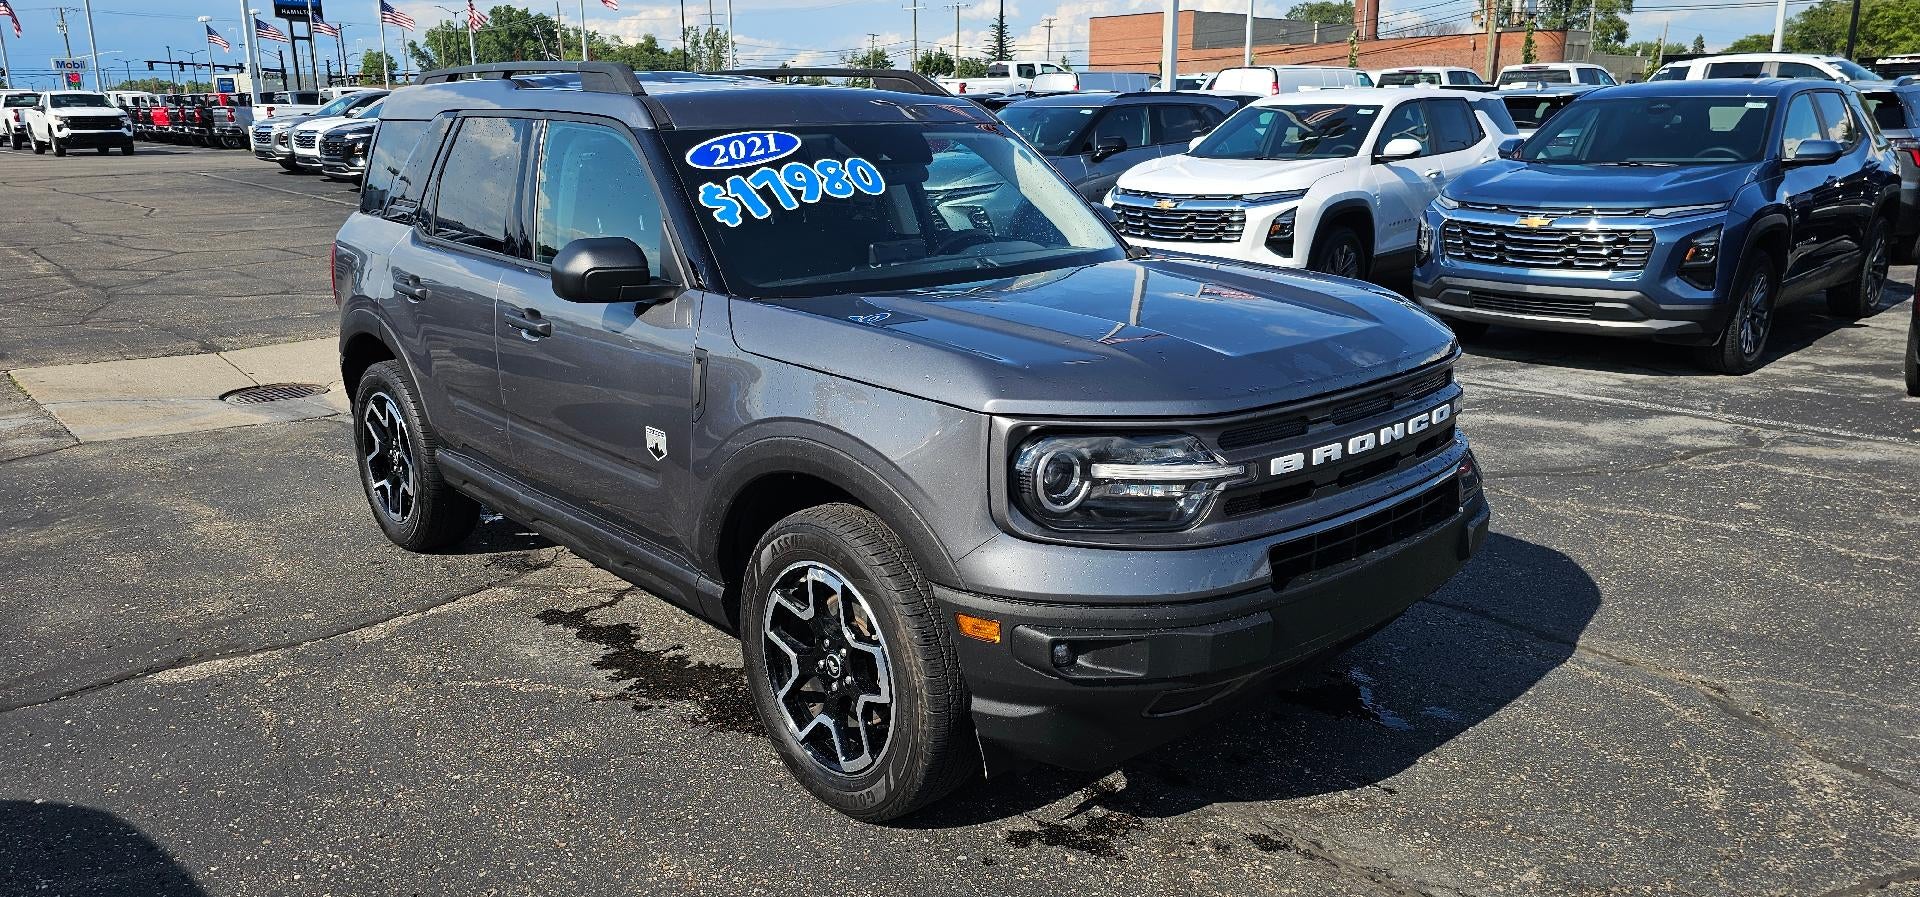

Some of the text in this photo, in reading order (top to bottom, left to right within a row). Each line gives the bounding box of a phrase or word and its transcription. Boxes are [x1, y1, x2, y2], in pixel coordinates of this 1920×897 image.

[55, 60, 86, 69] Mobil
[709, 133, 780, 166] 2021
[698, 157, 886, 228] $17980
[1269, 403, 1452, 476] BRONCO
